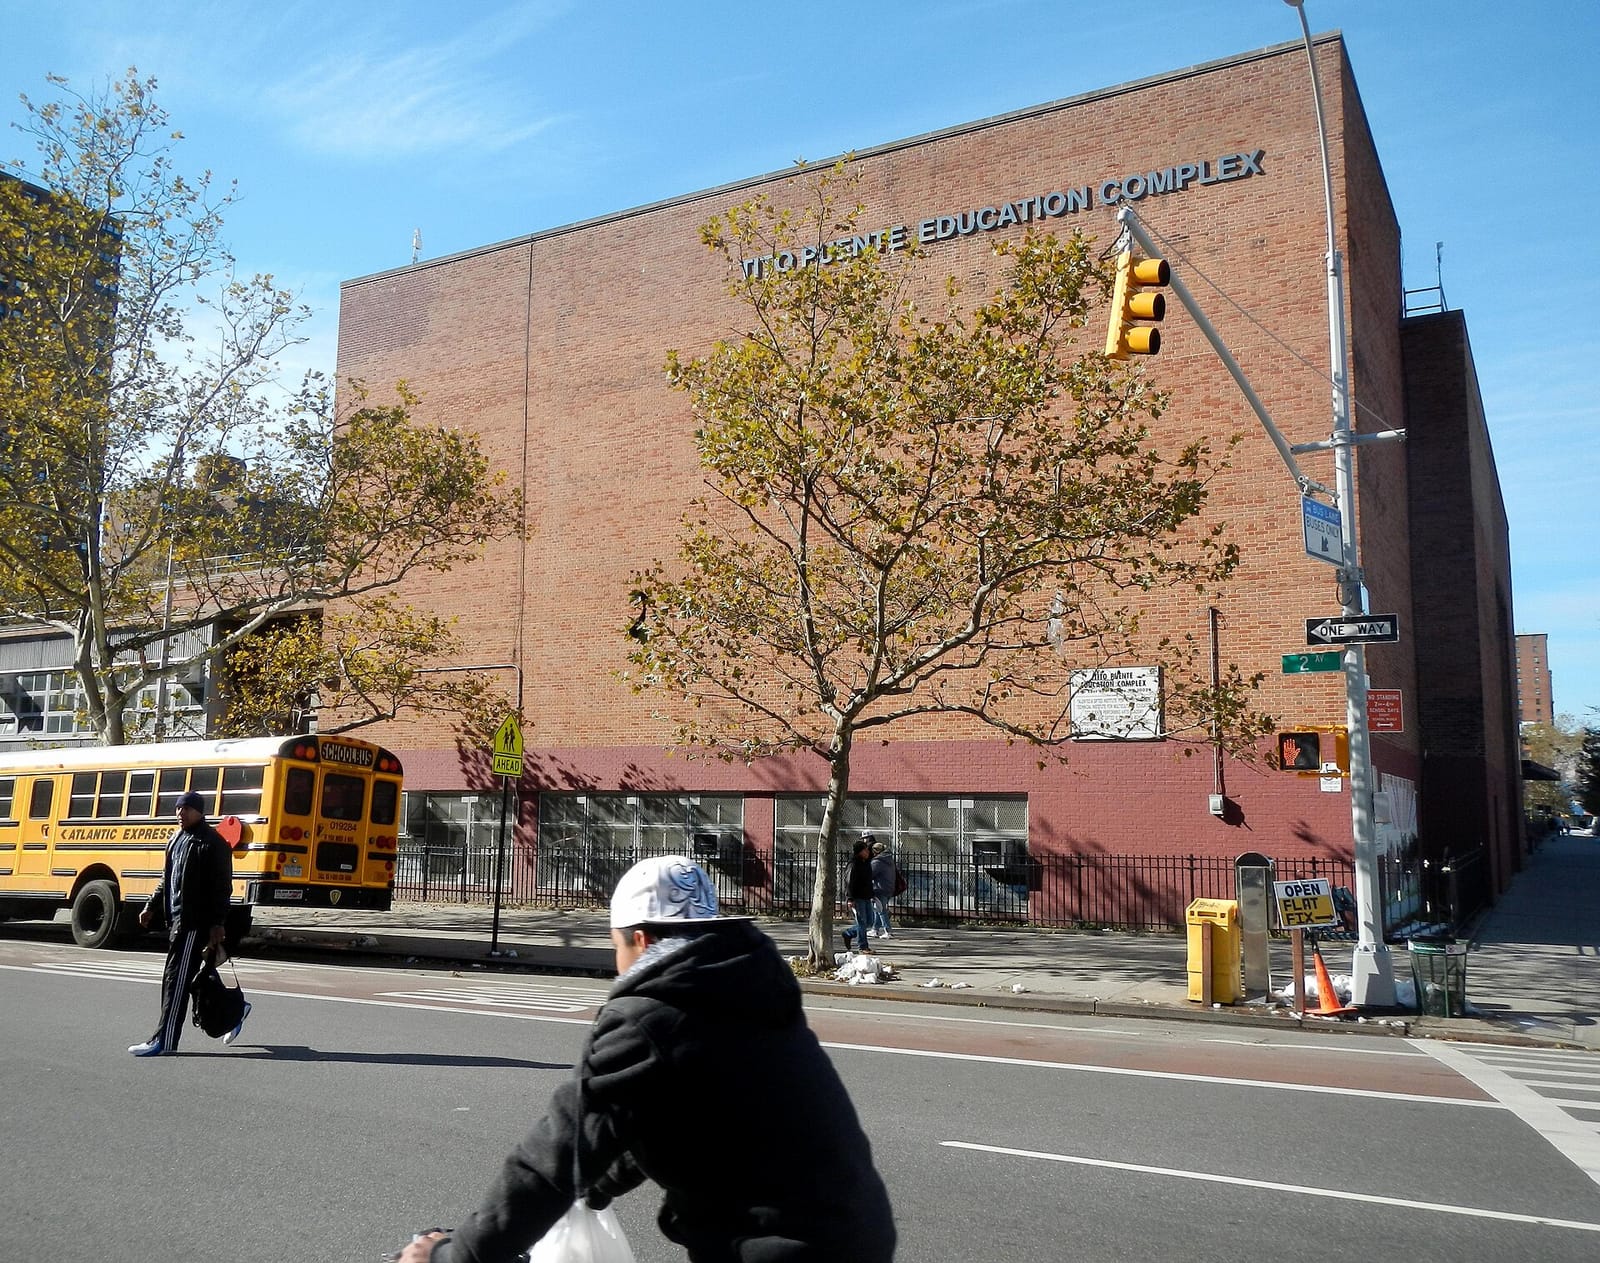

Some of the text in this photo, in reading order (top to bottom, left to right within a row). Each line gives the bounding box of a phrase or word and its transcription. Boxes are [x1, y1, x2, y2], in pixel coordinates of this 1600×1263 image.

[918, 185, 1092, 244] EDUCATION
[1099, 149, 1265, 206] COMPLEX
[1312, 504, 1325, 517] BUS
[1306, 515, 1325, 533] BUSES
[1320, 623, 1385, 636] ONE WAY
[1299, 654, 1324, 671] 2 AV
[322, 743, 373, 766] SCHOOL BUS
[496, 758, 520, 771] AHEAD
[68, 828, 175, 840] ATLANTIC EXPRESS
[1284, 883, 1321, 897] OPEN
[1283, 897, 1318, 911] FLAT
[1286, 911, 1314, 925] FIX
